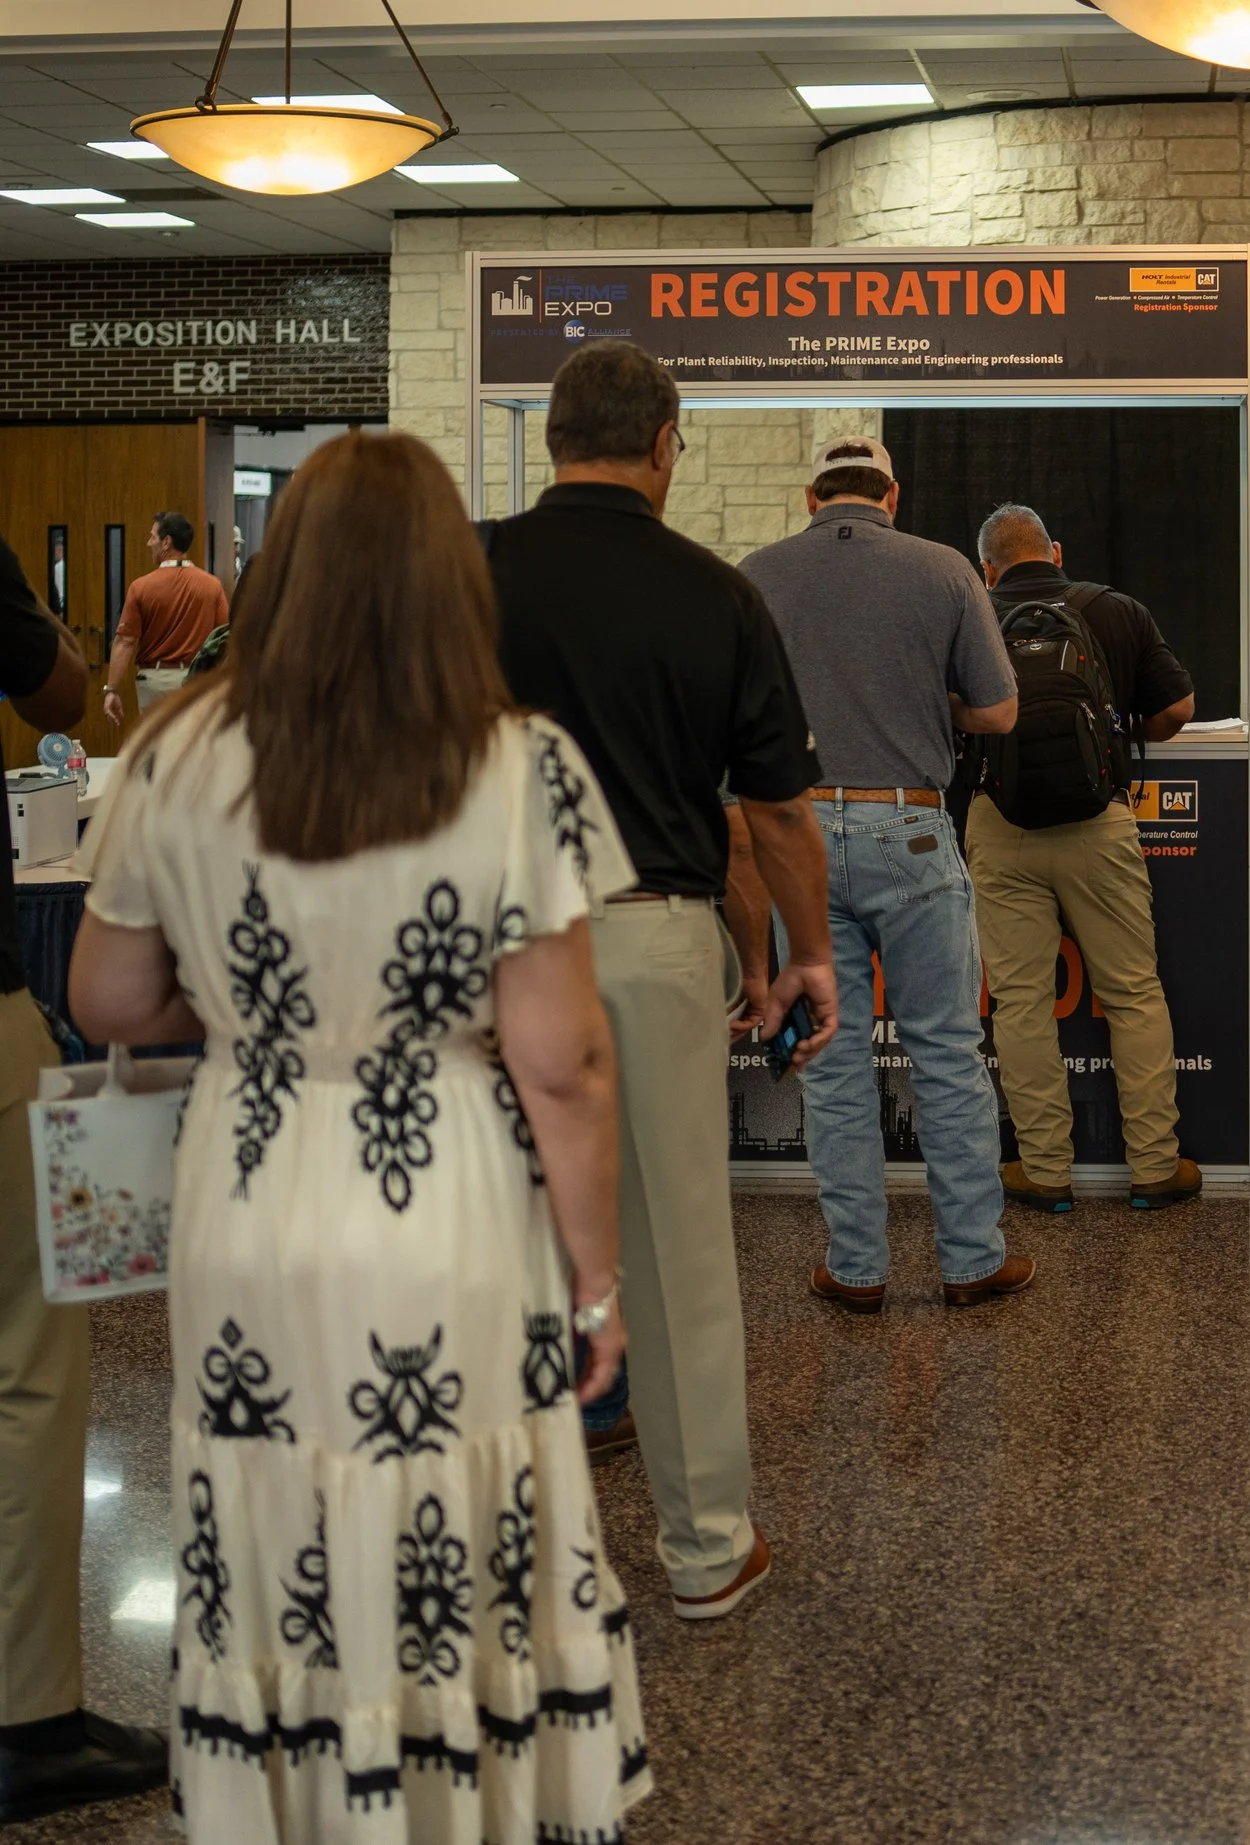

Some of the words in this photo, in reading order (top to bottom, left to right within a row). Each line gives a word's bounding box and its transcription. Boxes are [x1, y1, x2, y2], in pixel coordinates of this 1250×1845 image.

[547, 275, 577, 285] THE
[1197, 273, 1216, 285] CAT
[545, 285, 628, 300] PRIME
[651, 269, 1066, 317] REGISTRATION
[544, 301, 612, 317] EXPO
[1134, 303, 1182, 313] Registration
[1183, 303, 1219, 313] Sponsor
[69, 319, 258, 348] EXPOSITION
[275, 318, 361, 344] HALL
[491, 328, 543, 337] PRESENTED
[565, 326, 585, 338] BIC
[587, 328, 632, 337] ALLIANCE
[788, 336, 821, 351] The
[825, 336, 882, 351] PRIME
[886, 336, 931, 355] Expo
[657, 357, 675, 367] For
[677, 356, 706, 367] Plant
[708, 355, 766, 369] Reliability,
[768, 355, 829, 369] Inspection,
[831, 354, 899, 366] Maintenance
[902, 353, 922, 366] and
[924, 354, 989, 367] Engineering
[990, 353, 1064, 367] professionals
[173, 360, 251, 394] E&F
[1162, 791, 1193, 810] CAT
[1169, 830, 1199, 839] Control
[1142, 845, 1197, 858] ponsor
